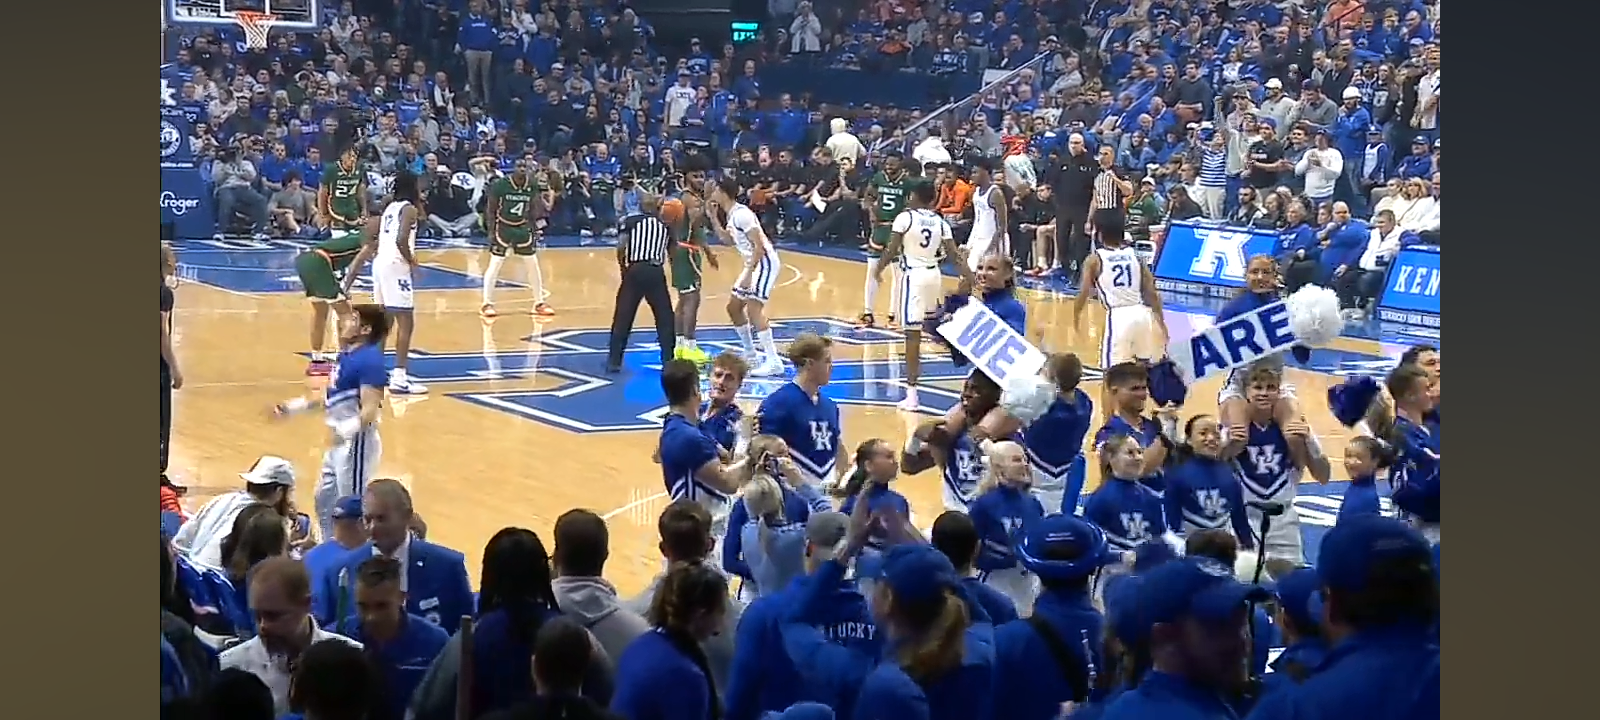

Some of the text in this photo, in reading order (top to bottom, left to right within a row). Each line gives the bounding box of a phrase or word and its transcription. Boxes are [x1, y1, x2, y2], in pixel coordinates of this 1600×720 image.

[335, 184, 357, 197] 24
[882, 194, 897, 210] 5
[510, 202, 524, 216] 4
[920, 228, 933, 248] 3
[1111, 263, 1133, 288] 21
[956, 310, 1027, 380] WE
[1190, 303, 1296, 379] ARE
[808, 420, 833, 451] UK
[1246, 444, 1283, 475] UK
